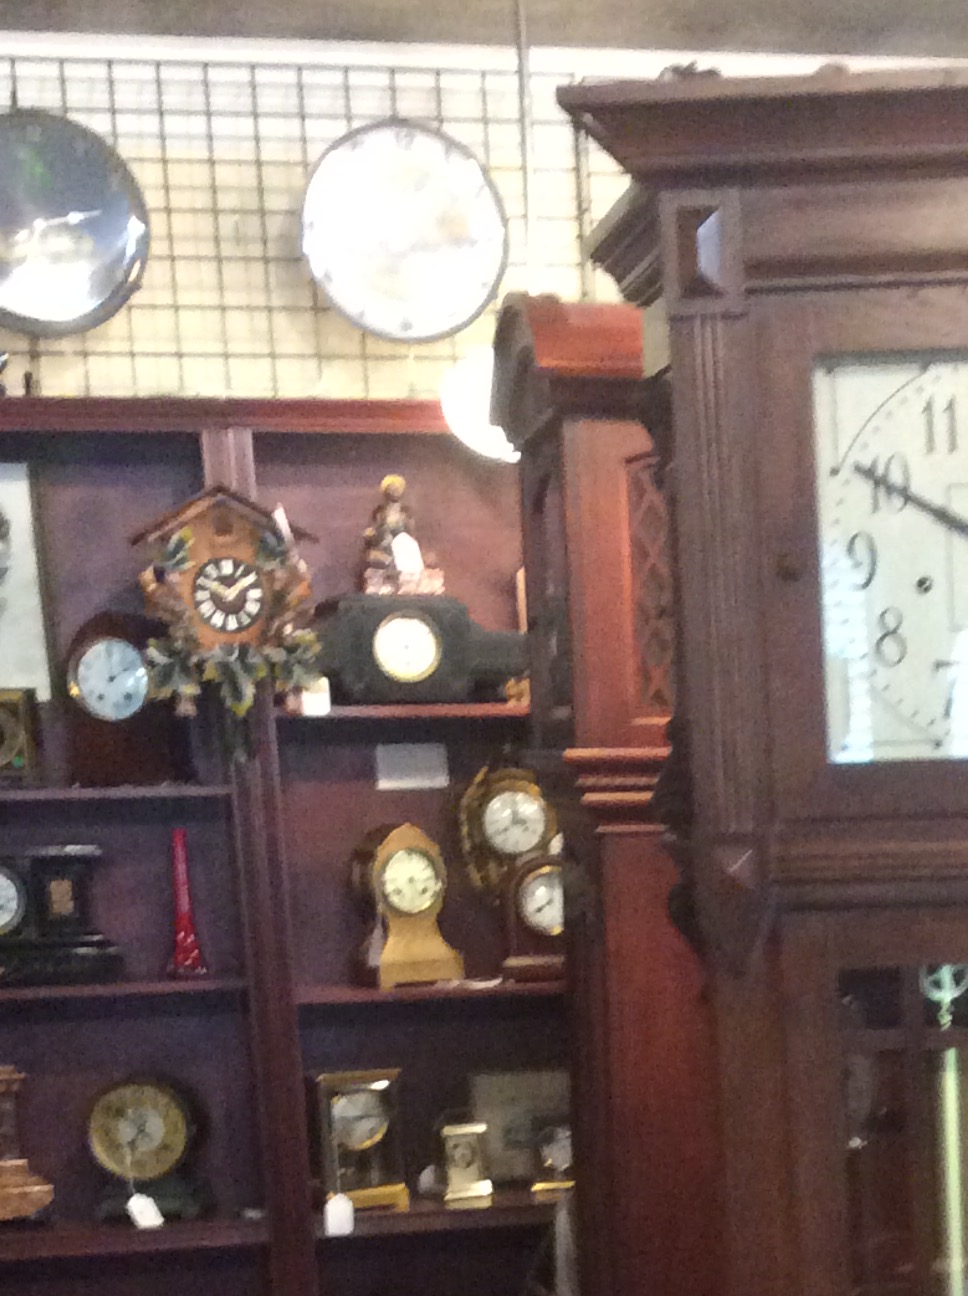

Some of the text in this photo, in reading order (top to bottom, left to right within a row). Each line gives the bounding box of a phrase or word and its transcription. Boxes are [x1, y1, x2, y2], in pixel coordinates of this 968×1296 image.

[920, 393, 958, 455] 11
[868, 453, 911, 514] 10
[847, 530, 878, 590] 9
[874, 606, 908, 668] 8
[933, 659, 959, 719] 7
